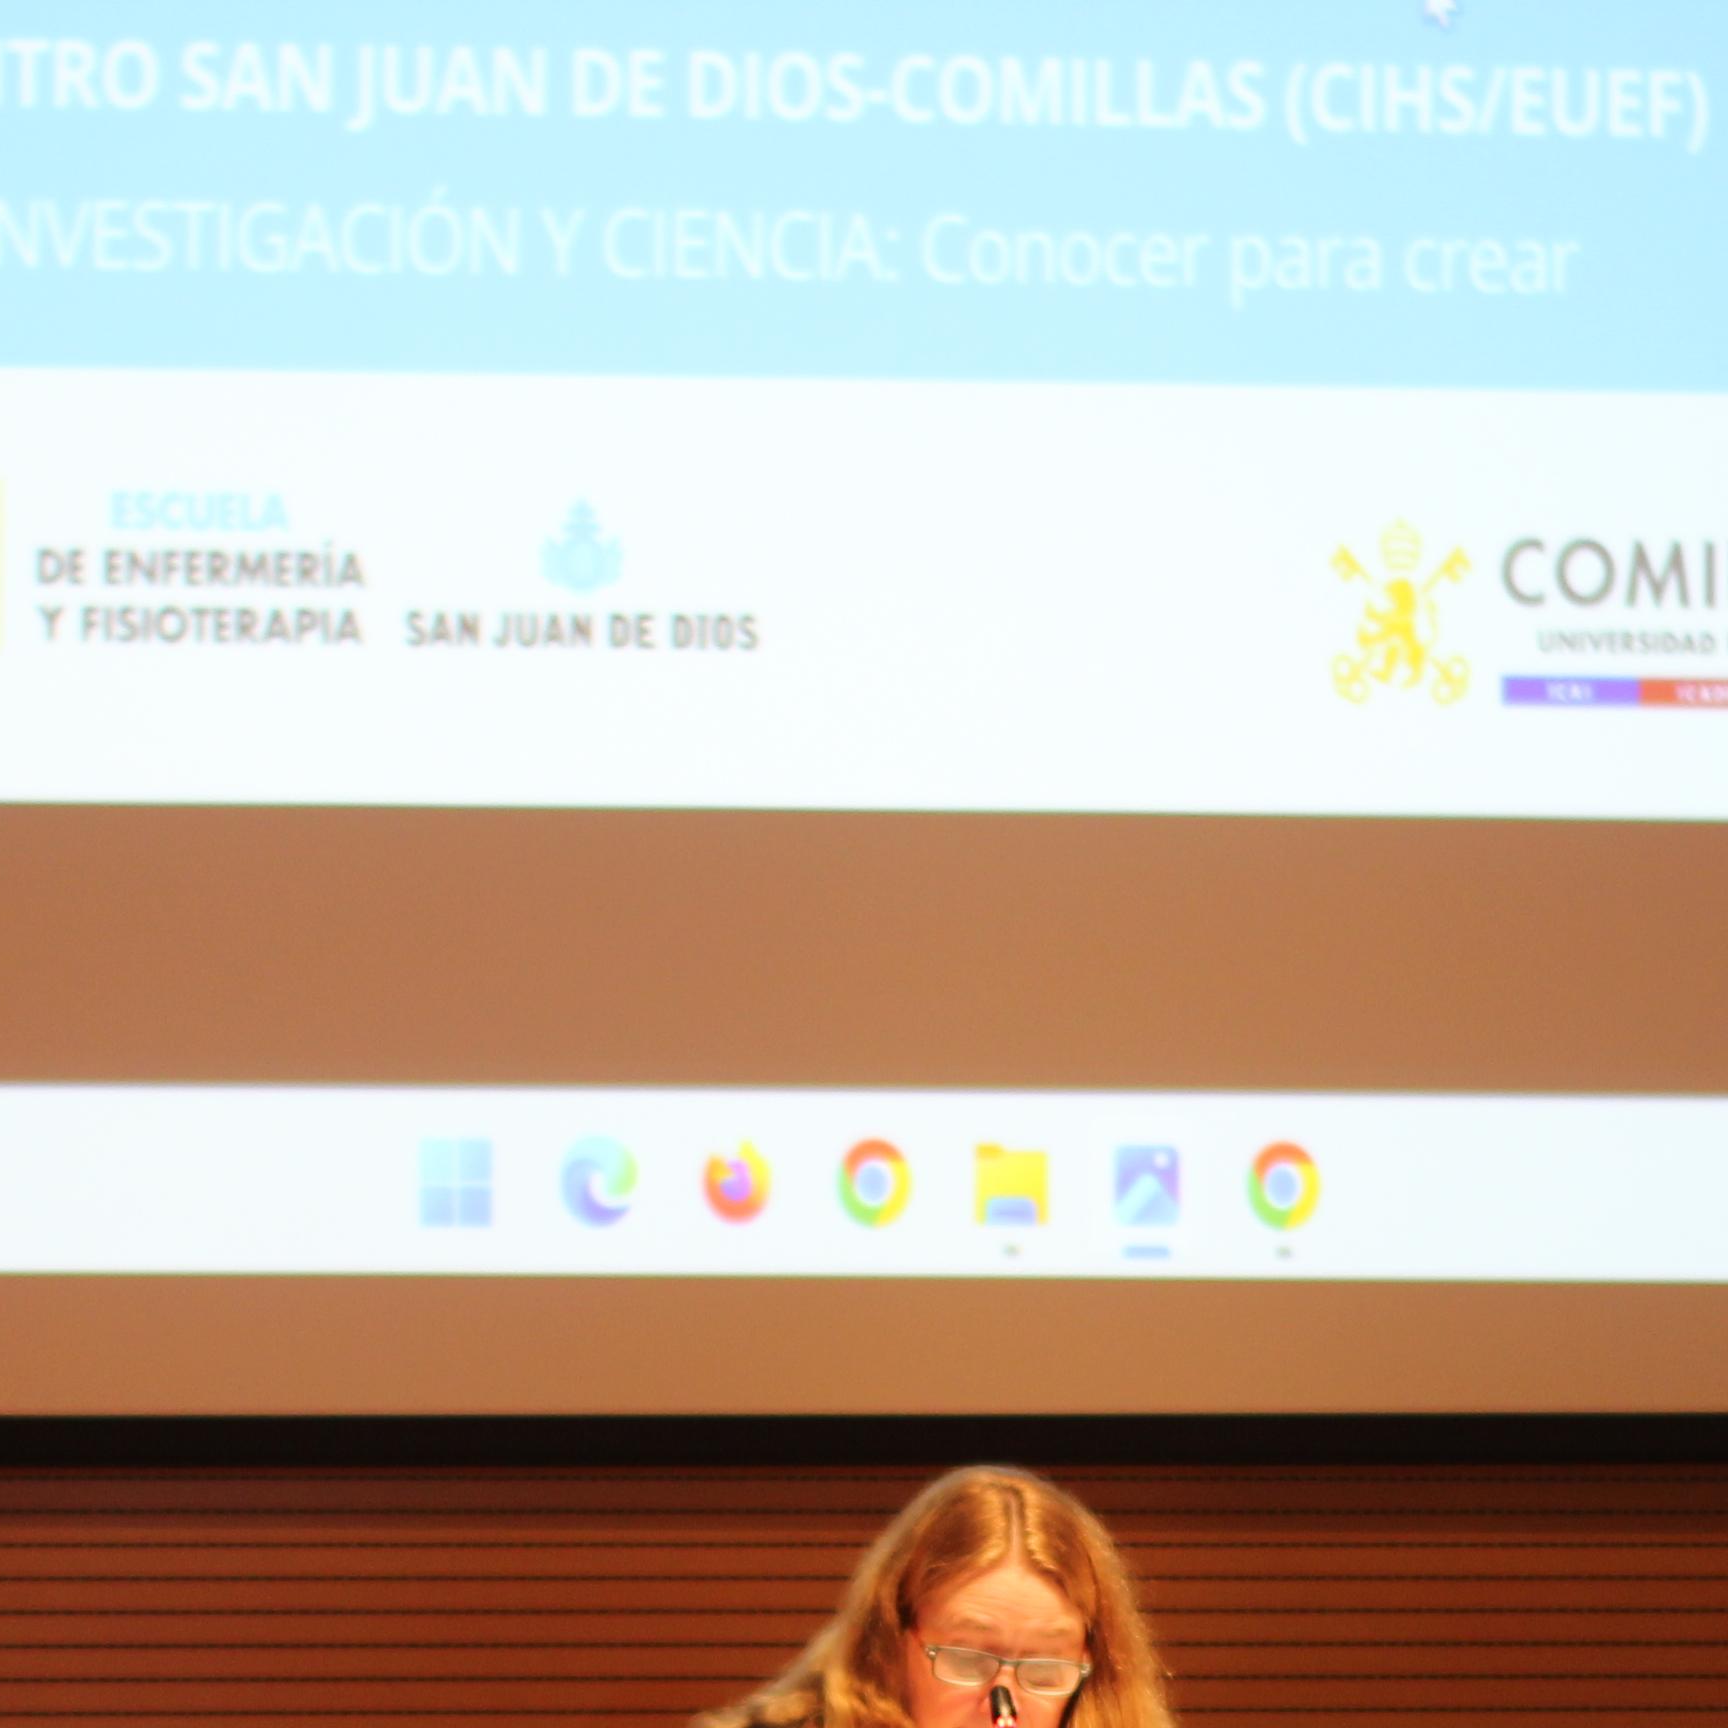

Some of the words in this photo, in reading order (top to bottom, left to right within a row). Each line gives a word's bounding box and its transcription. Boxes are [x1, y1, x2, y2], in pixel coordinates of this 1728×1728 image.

[178, 38, 334, 113] SAN
[345, 44, 548, 132] JUAN
[571, 47, 665, 118] DE
[687, 50, 1267, 129] DIOS-COMILLAS
[1284, 60, 1710, 154] (CIHS/EUEF)
[540, 208, 586, 275] Y
[603, 206, 899, 281] CIENCIA:
[921, 213, 1209, 287] Conocer
[1230, 234, 1382, 308] para
[1404, 237, 1581, 294] crear
[109, 490, 290, 533] ESCUELA
[33, 546, 84, 586] DE
[101, 540, 365, 589] ENFERMERÍA
[35, 604, 63, 641] Y
[79, 604, 362, 645] FISIOTERAPIA
[402, 609, 479, 648] SAN
[491, 611, 593, 649] JUAN
[605, 611, 656, 650] DE
[668, 611, 760, 652] DIOS
[1536, 629, 1717, 656] UNIVERSIDAD
